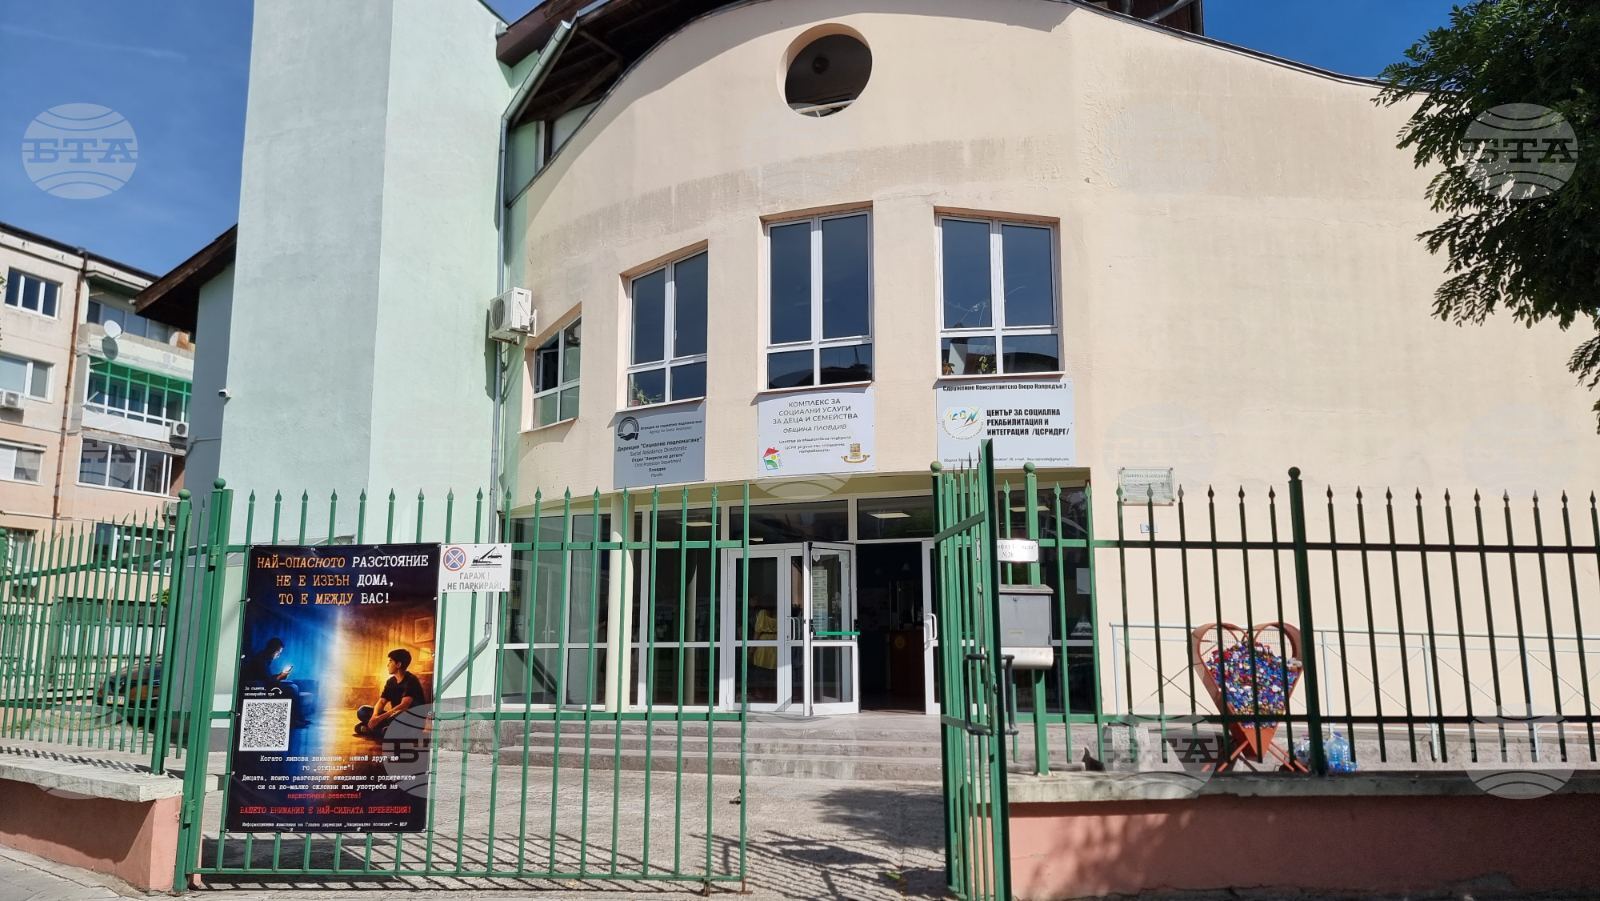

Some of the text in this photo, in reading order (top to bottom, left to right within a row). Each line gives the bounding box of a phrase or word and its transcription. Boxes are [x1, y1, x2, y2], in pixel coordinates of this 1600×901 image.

[788, 400, 829, 408] КОМПЛЕКС
[778, 405, 851, 417] СОЦИАЛНИ УСЛУГИ
[986, 409, 1013, 417] ЦЕНТЪР
[1023, 408, 1061, 416] СОЦИАЛНА
[783, 416, 804, 425] ДЕЦА
[812, 412, 858, 422] СЕМЕЙСТВА
[986, 418, 1043, 426] РЕХАБИЛИТАЦИЯ
[782, 423, 847, 434] ОБЩИНА ПЛОВДИВ
[986, 428, 1029, 436] ИНТЕГРАЦИЯ
[257, 554, 429, 569] НАЙ-ОПАСНОТО РАЗСТОЯНИЕ
[459, 571, 485, 580] ГАРАЖ
[276, 574, 395, 588] НЕ Е ИЗВЪН ДОМА,
[447, 582, 458, 590] НЕ
[278, 592, 390, 606] ТО Е МЕЖДУ ВАС!
